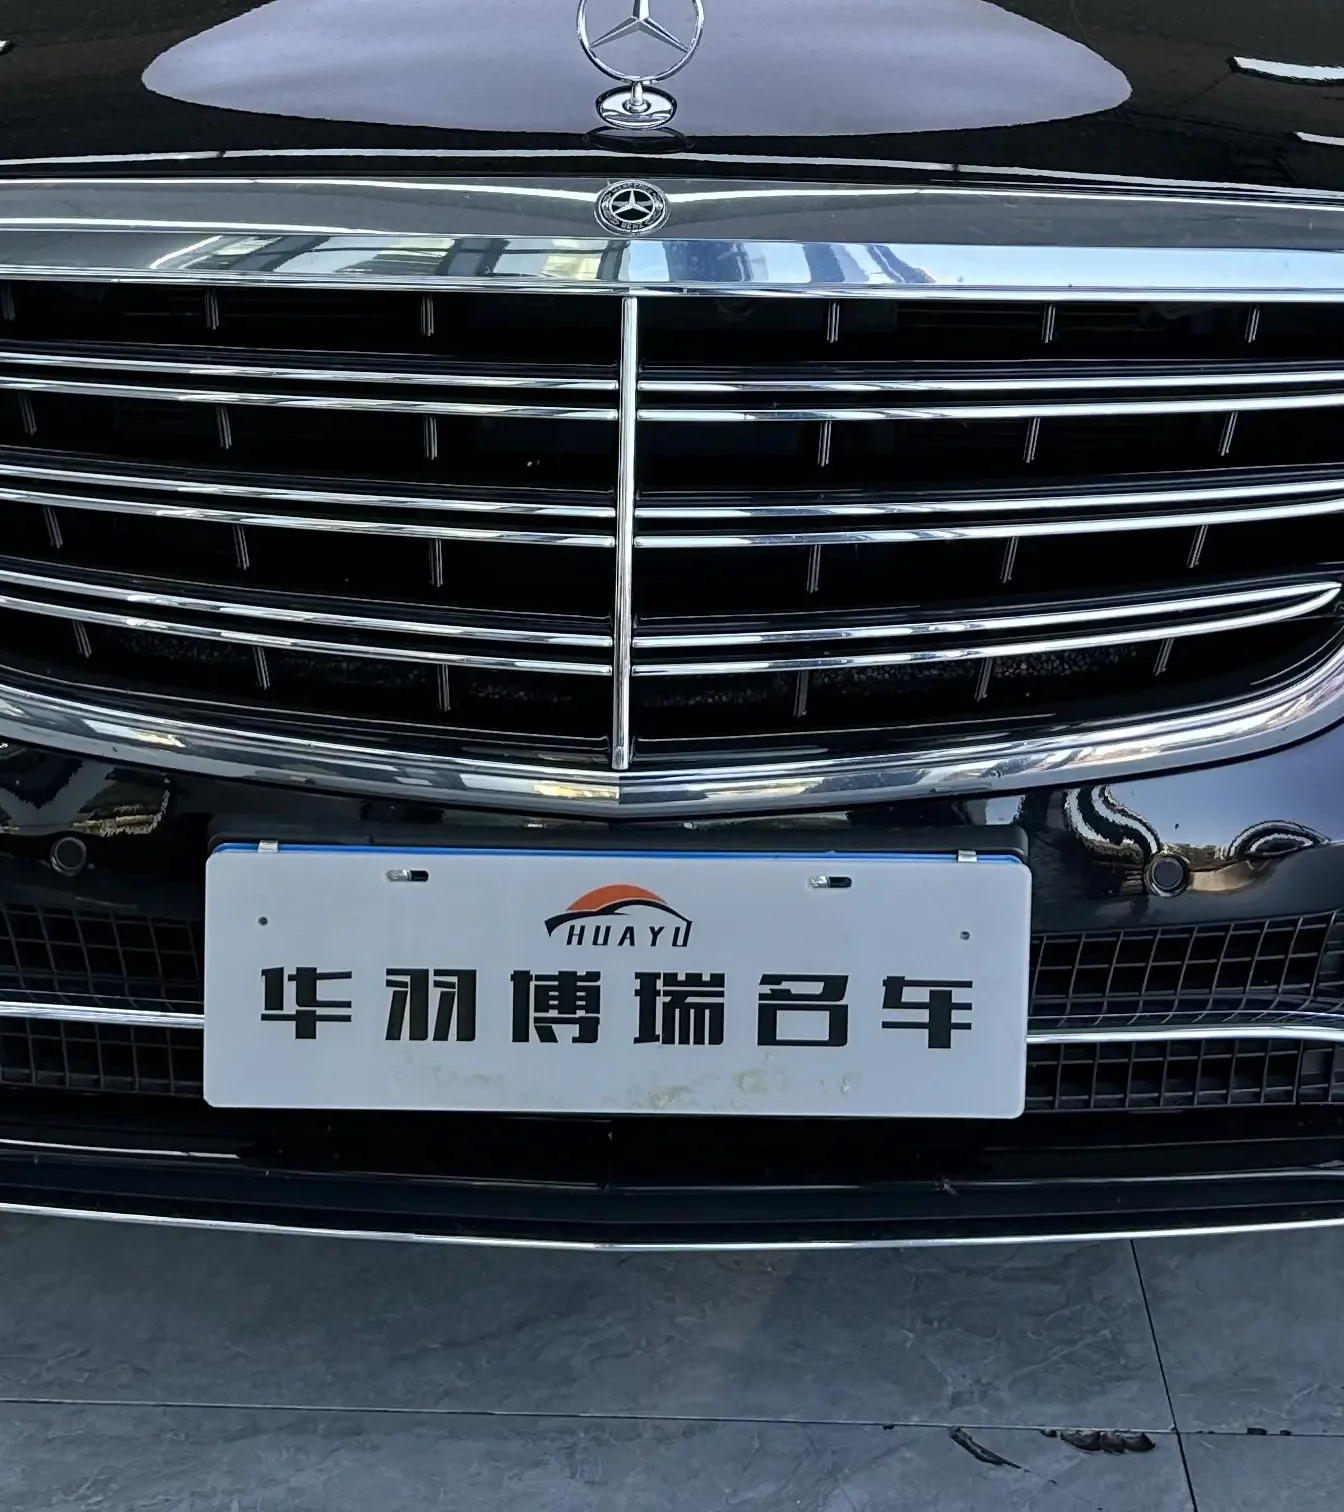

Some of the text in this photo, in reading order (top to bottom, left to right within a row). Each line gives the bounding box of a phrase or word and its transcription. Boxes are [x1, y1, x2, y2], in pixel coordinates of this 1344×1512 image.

[566, 924, 693, 947] HUAYU
[260, 966, 973, 1049] 华羽博瑞名车
